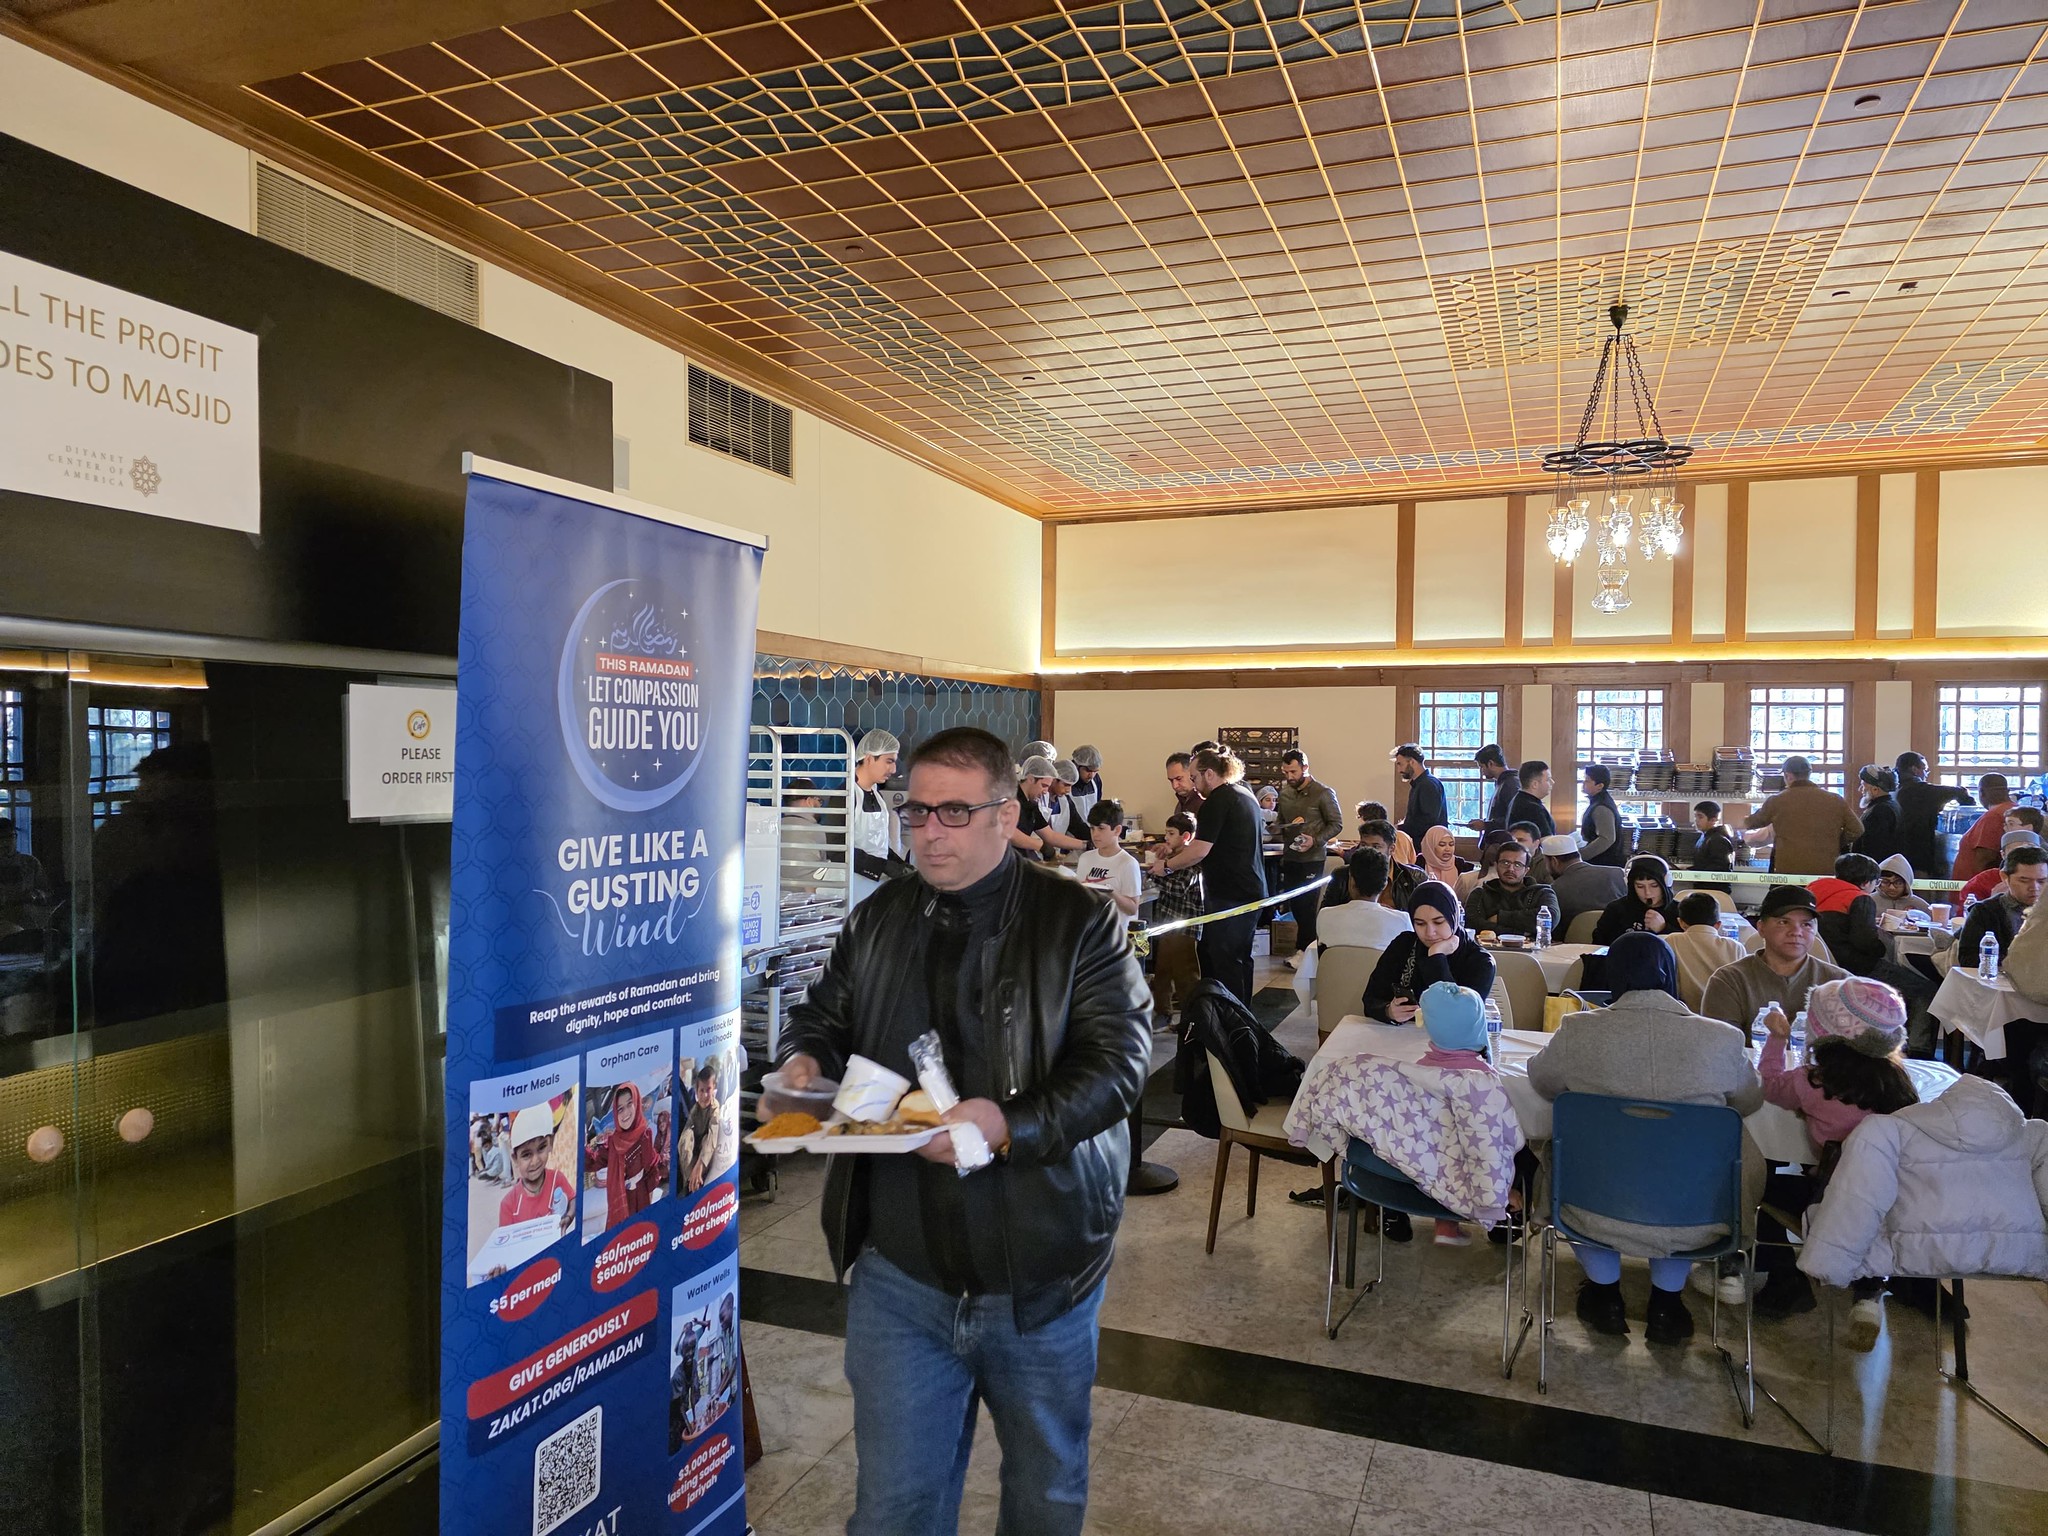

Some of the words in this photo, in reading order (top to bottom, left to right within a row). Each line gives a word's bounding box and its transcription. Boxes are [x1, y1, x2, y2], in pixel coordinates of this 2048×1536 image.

[40, 292, 106, 339] THE
[119, 317, 224, 372] PROFIT
[65, 356, 110, 394] TO
[124, 373, 231, 425] MASJID
[47, 453, 101, 471] CENTER
[109, 466, 123, 476] OF
[65, 444, 123, 464] DIYANET
[64, 469, 123, 488] AMERICA
[600, 657, 627, 672] THIS
[630, 660, 689, 677] RAMADAN
[588, 675, 611, 703] LET
[614, 678, 699, 708] COMPASSION
[588, 706, 654, 750] GUIDE
[658, 710, 699, 751] YOU
[401, 748, 441, 760] PLEASE
[382, 772, 423, 784] ORDER
[426, 771, 455, 784] FIRST
[558, 834, 623, 872] GIVE
[629, 830, 685, 864] LIKE
[690, 829, 709, 859] A
[567, 866, 700, 914] GUSTING
[1088, 867, 1110, 879] NIKE
[581, 890, 687, 957] Wind
[529, 1005, 558, 1024] Reap
[560, 1001, 576, 1017] the
[577, 990, 617, 1011] rewards
[619, 986, 629, 1001] of
[630, 976, 678, 997] Ramadan
[679, 972, 698, 987] and
[699, 968, 720, 985] bring
[566, 1014, 602, 1035] dignity,
[604, 1007, 629, 1024] hope
[631, 1001, 650, 1016] and
[652, 992, 692, 1011] comfort:
[697, 1019, 727, 1037] Livestock
[699, 1030, 733, 1048] Livelihoods
[600, 1050, 636, 1069] Orphan
[637, 1043, 660, 1059] Care
[502, 1083, 528, 1098] Iftar
[530, 1073, 560, 1092] Meals
[683, 1190, 735, 1226] $200/mating
[671, 1228, 694, 1251] goat
[695, 1223, 706, 1237] or
[705, 1209, 729, 1231] sheep
[594, 1231, 654, 1269] $50/month
[596, 1250, 652, 1286] $600/year
[489, 1295, 508, 1315] $5
[510, 1286, 533, 1310] per
[533, 1267, 562, 1295] meal
[686, 1280, 712, 1301] Water
[712, 1267, 731, 1288] Wells
[509, 1365, 544, 1392] GIVE
[545, 1309, 632, 1370] GENEROUSLY
[488, 1333, 645, 1440] ZAKAT.ORG/RAMADAN
[667, 1475, 699, 1506] lasting
[699, 1445, 736, 1480] sadaqah
[678, 1449, 708, 1481] $3,000
[708, 1441, 721, 1459] for
[721, 1436, 729, 1449] a
[686, 1474, 718, 1509] jariyah
